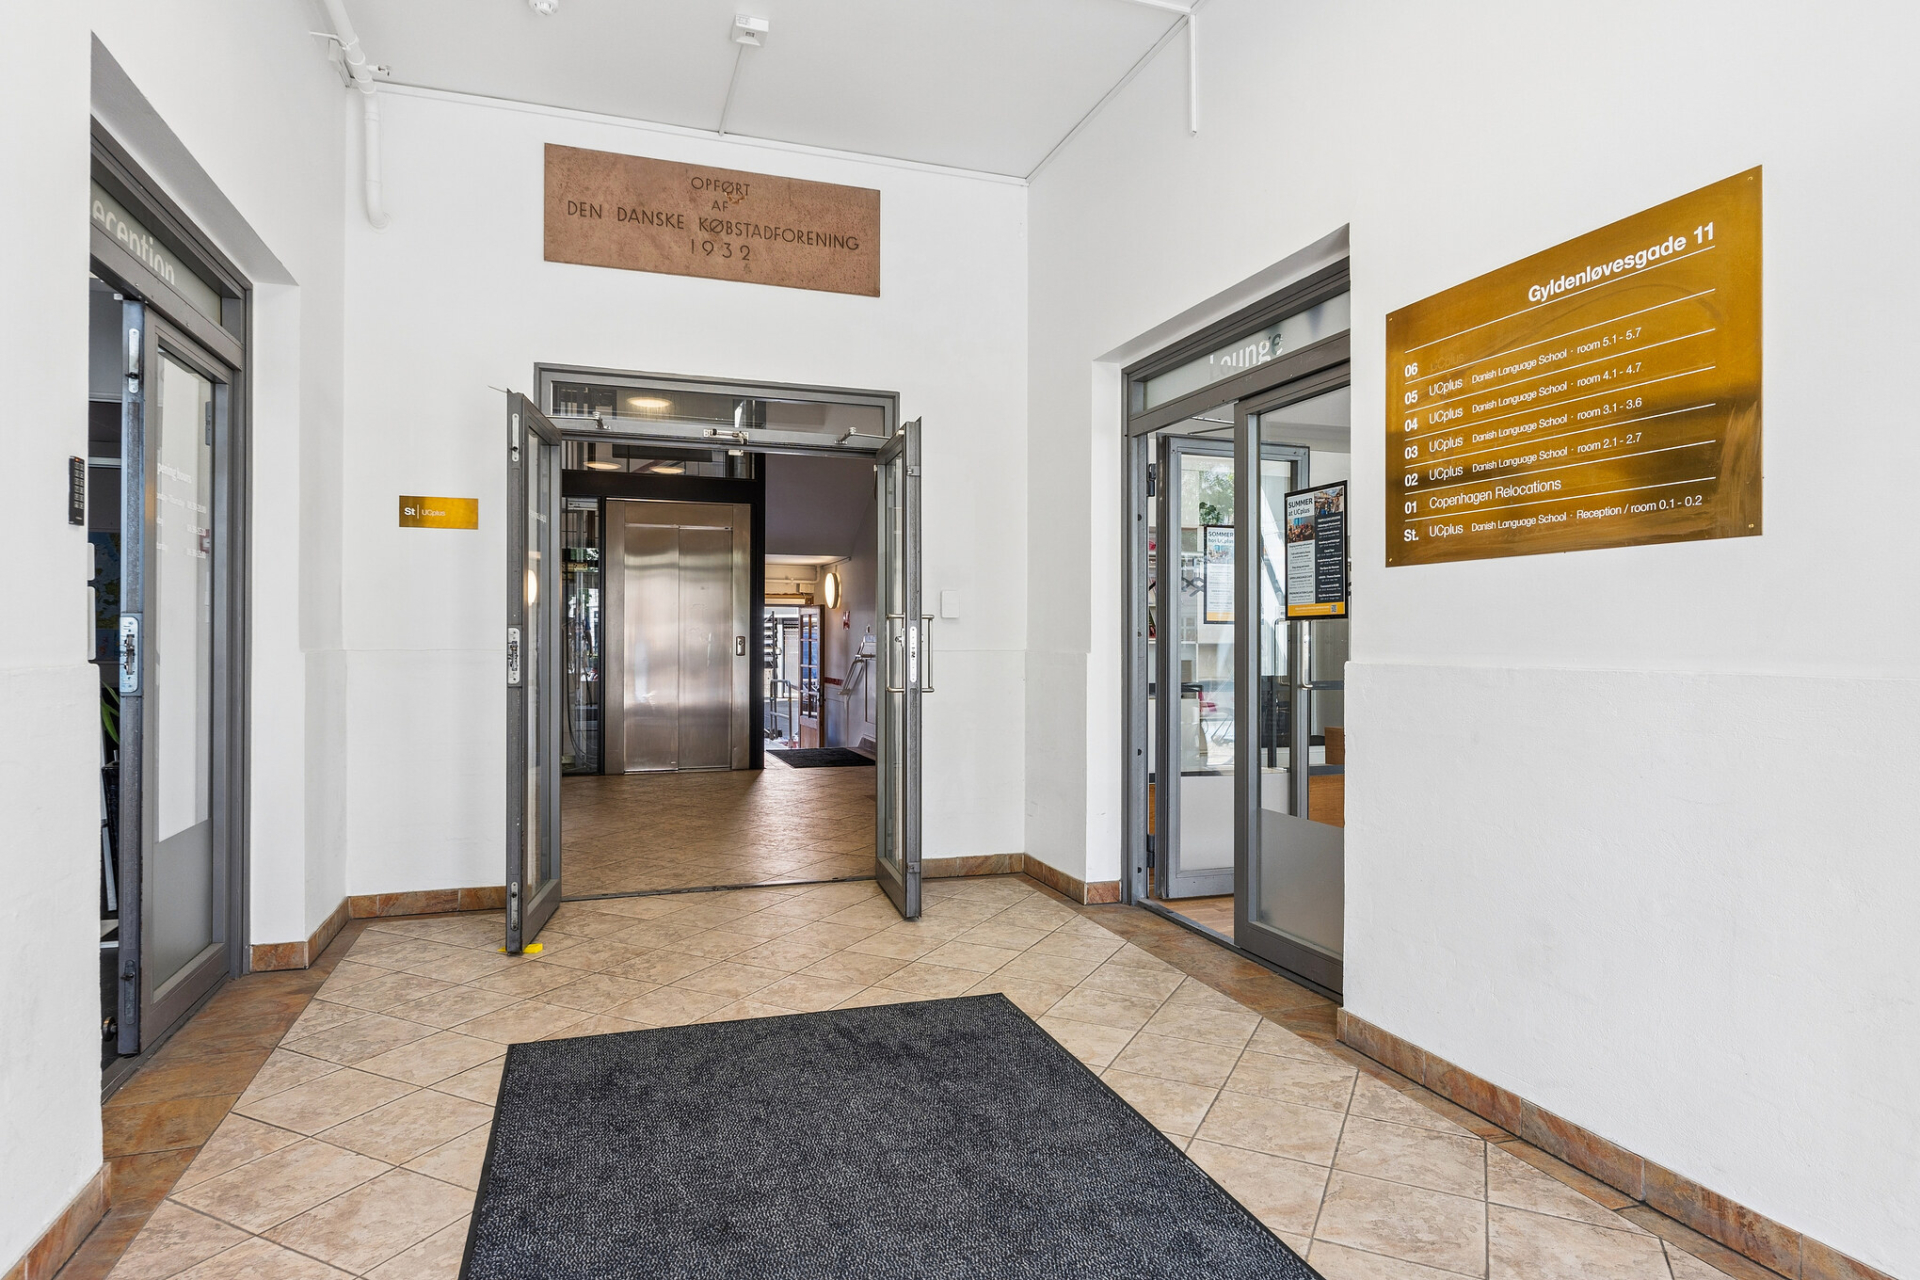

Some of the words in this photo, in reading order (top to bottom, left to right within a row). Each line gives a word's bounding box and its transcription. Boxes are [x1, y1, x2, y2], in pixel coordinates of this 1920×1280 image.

[690, 176, 751, 197] OPFØRT
[711, 200, 729, 213] AF
[92, 200, 174, 286] eception
[568, 200, 602, 220] DEN
[617, 206, 684, 230] DANSKE
[699, 217, 860, 251] KØBSTADFORENING
[690, 239, 751, 261] 1932
[1528, 236, 1687, 302] Gyldenløvesgade
[1693, 221, 1714, 244] 11
[1404, 390, 1418, 405] 05
[1429, 378, 1463, 396] UCplus
[1472, 369, 1496, 384] Danish
[1498, 358, 1536, 376] Language
[1538, 348, 1567, 364] School
[1577, 340, 1600, 354] room
[1602, 334, 1617, 347] 5.1
[1626, 327, 1642, 340] 5.7
[1404, 362, 1418, 378] 06
[1404, 418, 1418, 432] 04
[1429, 407, 1463, 424] UCplus
[1472, 398, 1497, 413] Danish
[1498, 389, 1537, 406] Language
[1538, 381, 1567, 397] School
[1577, 374, 1600, 387] room
[1602, 369, 1617, 380] 4.1
[1626, 362, 1642, 374] 4.7
[1404, 446, 1418, 460] 03
[1429, 436, 1463, 452] UCplus
[1472, 428, 1497, 443] Danish
[1498, 419, 1537, 437] Language
[1538, 414, 1567, 428] School
[1577, 408, 1600, 420] room
[1603, 403, 1617, 415] 3.1
[1626, 397, 1642, 410] 3.6
[1404, 473, 1418, 487] 02
[1429, 466, 1463, 480] UCplus
[1472, 460, 1497, 472] Danish
[1498, 451, 1537, 468] Language
[1539, 446, 1567, 460] School
[1577, 441, 1600, 453] room
[1603, 437, 1617, 448] 2.1
[1626, 432, 1642, 444] 2.7
[404, 507, 416, 516] St
[421, 509, 446, 517] UCplus
[1288, 498, 1313, 508] SUMMER
[1294, 508, 1310, 516] UCplus
[1404, 500, 1417, 514] 01
[1429, 490, 1493, 509] Copenhagen
[1495, 479, 1562, 499] Relocations
[1404, 529, 1419, 542] St.
[1429, 523, 1463, 538] UCplus
[1471, 521, 1496, 532] Danish
[1497, 515, 1536, 529] Language
[1538, 512, 1567, 524] School
[1576, 506, 1622, 520] Reception
[1630, 502, 1657, 513] room
[1658, 499, 1675, 510] 0.1
[1684, 495, 1702, 506] 0.2
